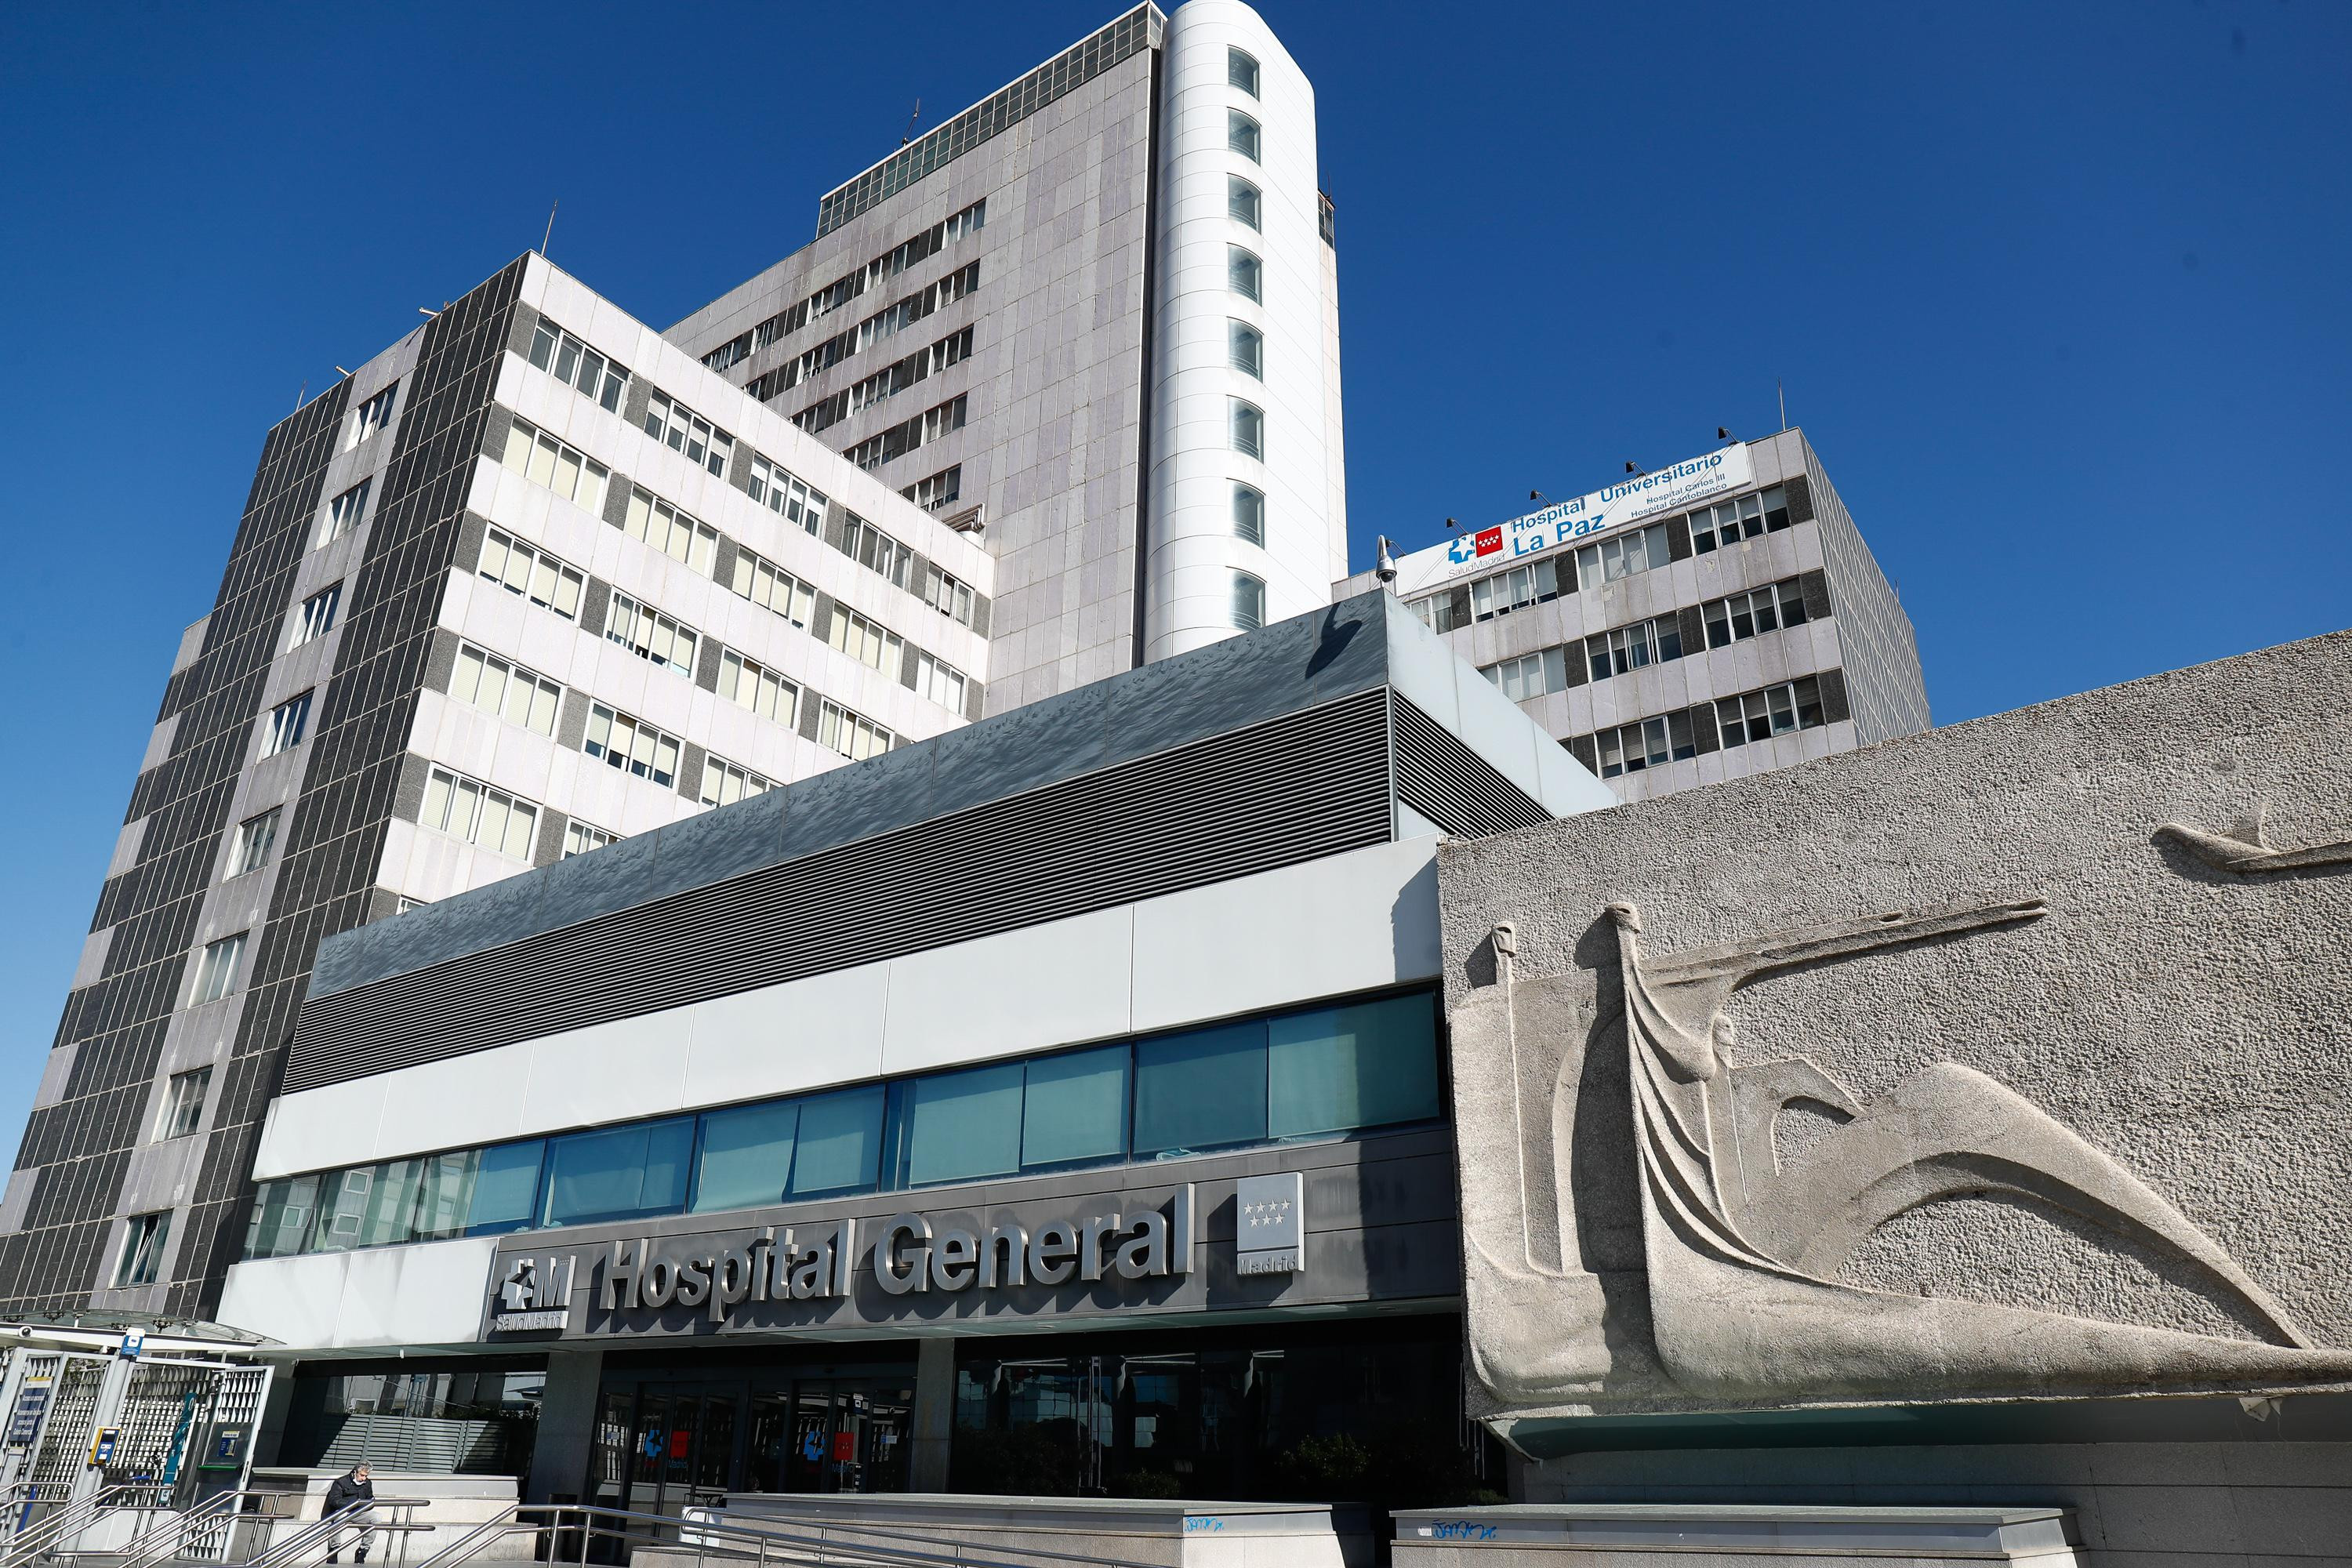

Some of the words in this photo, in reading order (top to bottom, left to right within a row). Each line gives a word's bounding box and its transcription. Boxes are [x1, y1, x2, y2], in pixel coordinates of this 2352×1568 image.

[1512, 498, 1585, 532] Hospital
[1600, 455, 1722, 503] Universitario
[1631, 503, 1667, 517] Hospital
[1669, 483, 1727, 506] Cantoblanco
[1646, 487, 1683, 504] Hospital
[1685, 477, 1714, 492] Carlos
[1717, 473, 1726, 481] III
[1513, 535, 1544, 556] La
[1556, 514, 1605, 542] Paz
[1448, 553, 1504, 579] SaludMadrid
[599, 1218, 856, 1322] Hospital
[874, 1182, 1195, 1295] General
[1238, 1255, 1298, 1275] Madrid
[495, 1311, 564, 1332] SaludMadrid
